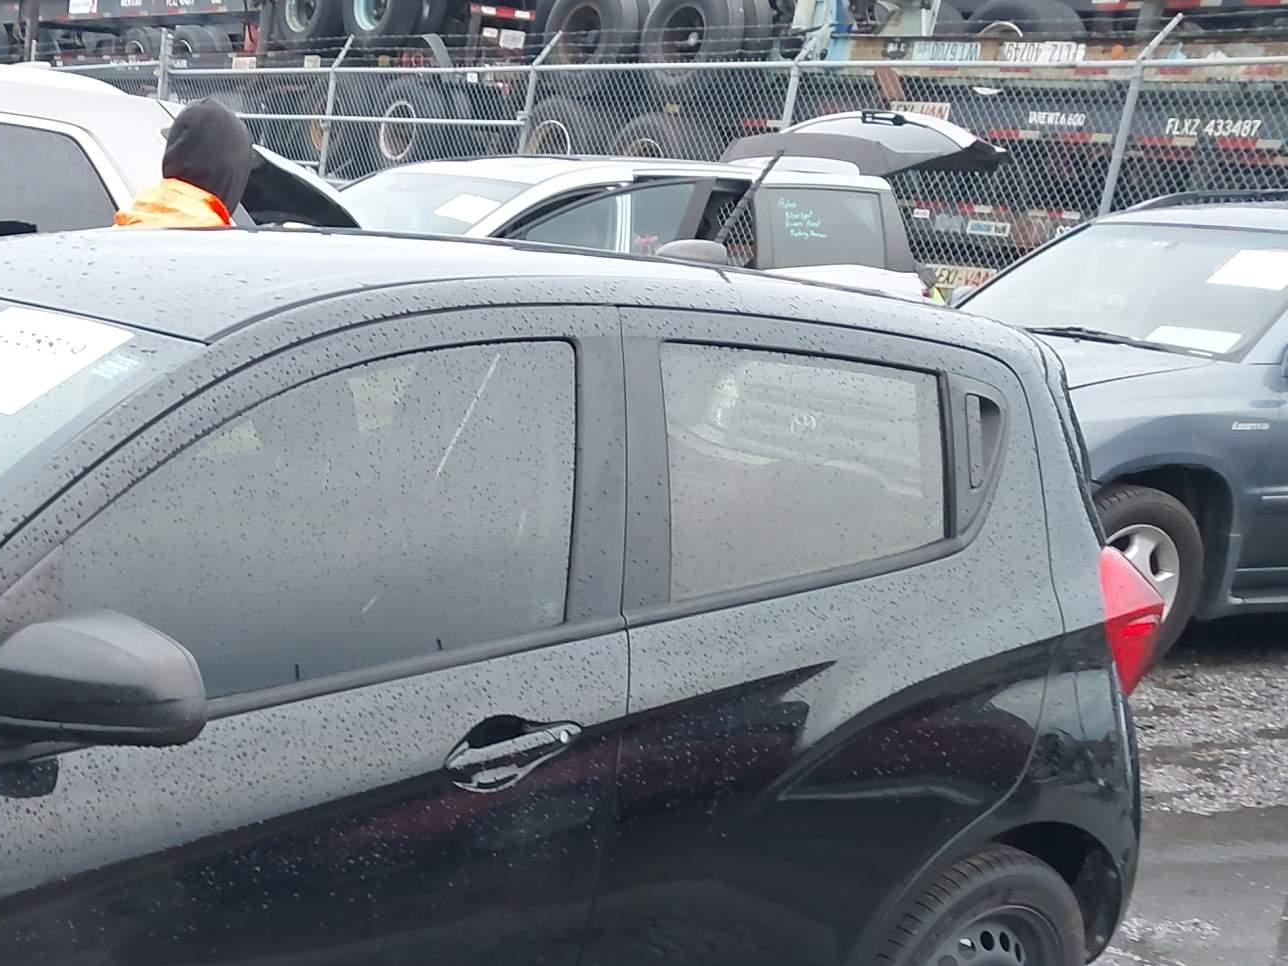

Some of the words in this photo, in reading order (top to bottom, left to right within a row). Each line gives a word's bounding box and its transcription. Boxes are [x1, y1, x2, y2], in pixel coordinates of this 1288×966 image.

[1004, 42, 1043, 62] 40749
[1165, 117, 1201, 136] FLXZ
[1203, 118, 1262, 138] 433487
